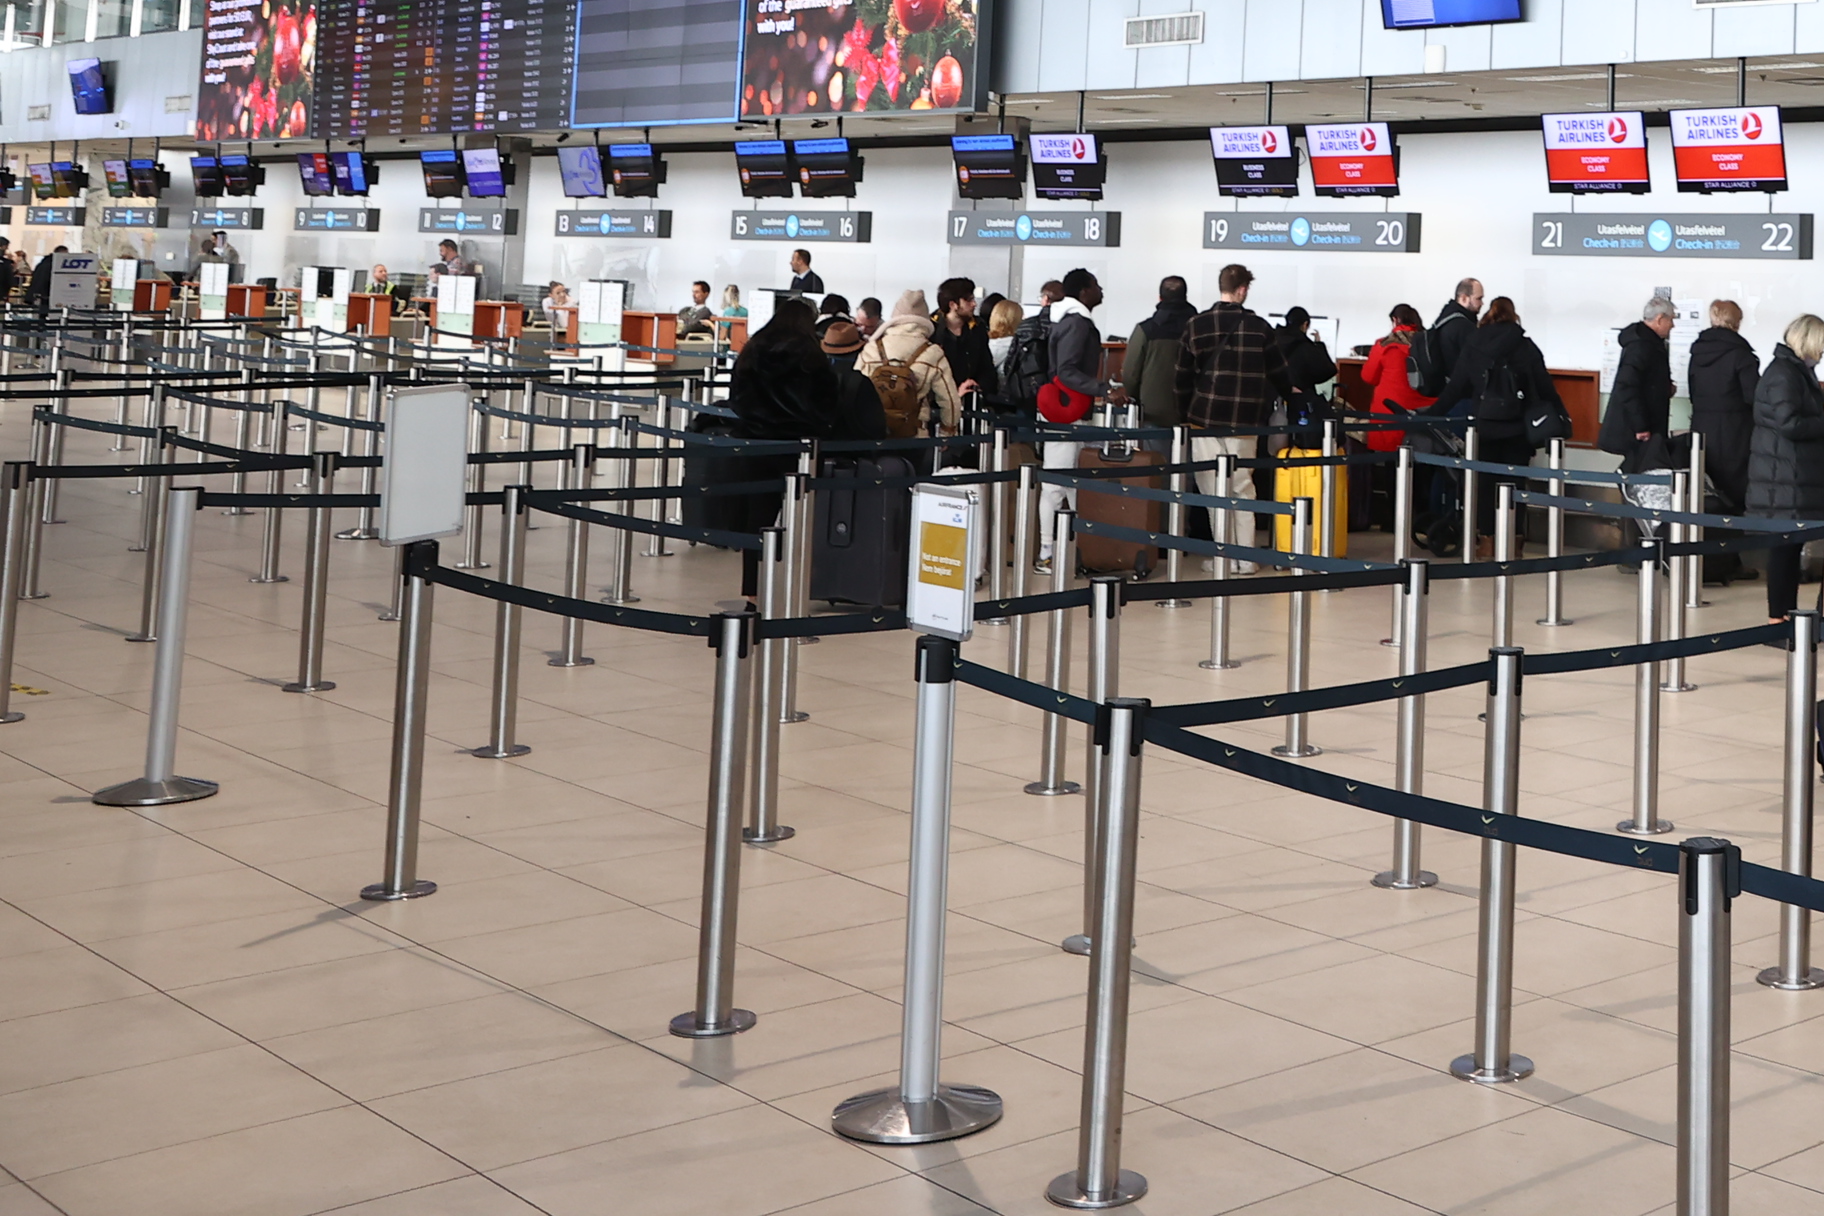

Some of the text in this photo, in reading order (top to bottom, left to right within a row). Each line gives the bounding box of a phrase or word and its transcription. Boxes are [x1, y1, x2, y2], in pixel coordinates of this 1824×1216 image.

[757, 17, 794, 35] with you!
[1557, 120, 1605, 131] TURKISH
[1685, 115, 1738, 128] TURKISH
[1221, 132, 1259, 142] TURKISH
[1317, 130, 1357, 140] TURKISH
[1558, 131, 1606, 143] AIRLINES
[1687, 127, 1739, 140] AIRLINES
[1039, 139, 1070, 148] TURKISH
[1224, 142, 1260, 152] AIRLINES
[1319, 140, 1359, 151] AIRLINES
[1040, 149, 1071, 158] AIRLINES
[1712, 153, 1743, 162] ECONOMY
[1580, 156, 1610, 165] ECONOMY
[1587, 165, 1606, 173] CLASS
[1719, 162, 1739, 171] CLASS
[298, 211, 305, 225] 9
[492, 213, 502, 230] 12
[644, 215, 654, 233] 14
[736, 216, 747, 235] 15
[840, 217, 853, 237] 16
[954, 217, 967, 237] 17
[1084, 218, 1100, 240] 18
[1597, 224, 1644, 235] Utasfelvétel
[1210, 219, 1228, 242] 19
[1375, 220, 1403, 245] 20
[1541, 222, 1563, 247] 21
[1675, 225, 1725, 236] Utasfelvétel
[1761, 223, 1793, 251] 22
[1583, 238, 1618, 248] Check-in
[1675, 239, 1713, 249] Check-in
[61, 258, 93, 269] LOT
[922, 552, 961, 566] Not an entrance
[922, 564, 933, 573] Nem
